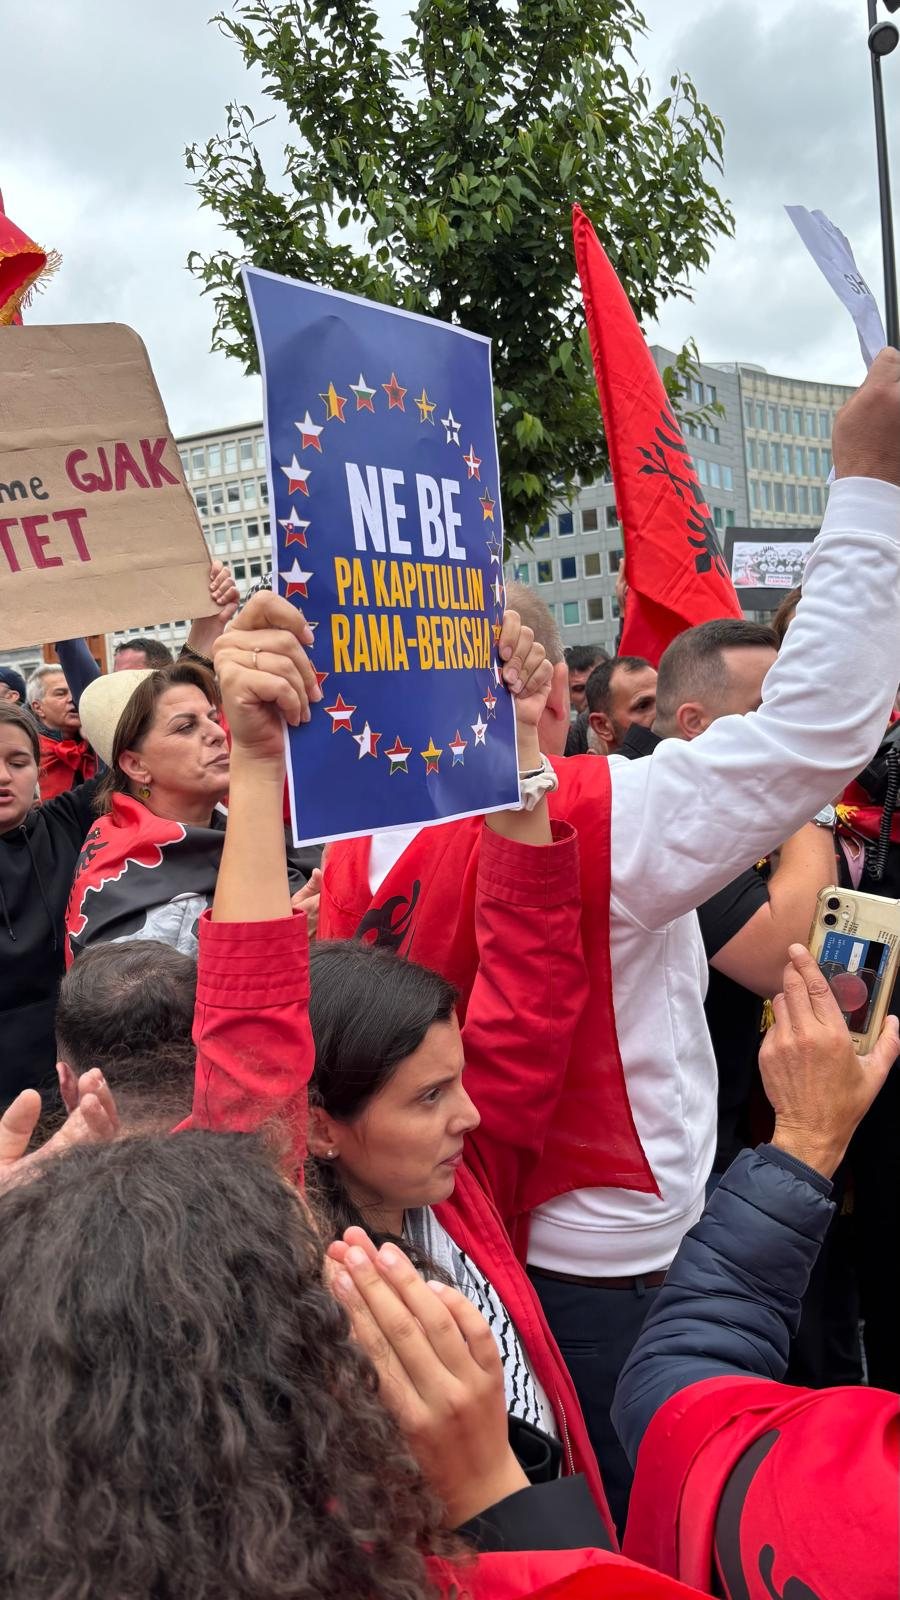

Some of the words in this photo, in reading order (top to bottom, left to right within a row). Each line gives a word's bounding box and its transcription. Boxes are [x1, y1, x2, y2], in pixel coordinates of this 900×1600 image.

[65, 439, 181, 493] GJAK
[0, 508, 91, 573] TET
[345, 462, 412, 555] NE
[415, 473, 466, 560] BE
[334, 556, 369, 606] PA
[372, 559, 485, 611] KAPITULLIN
[331, 613, 490, 672] RAMA-BERISHA
